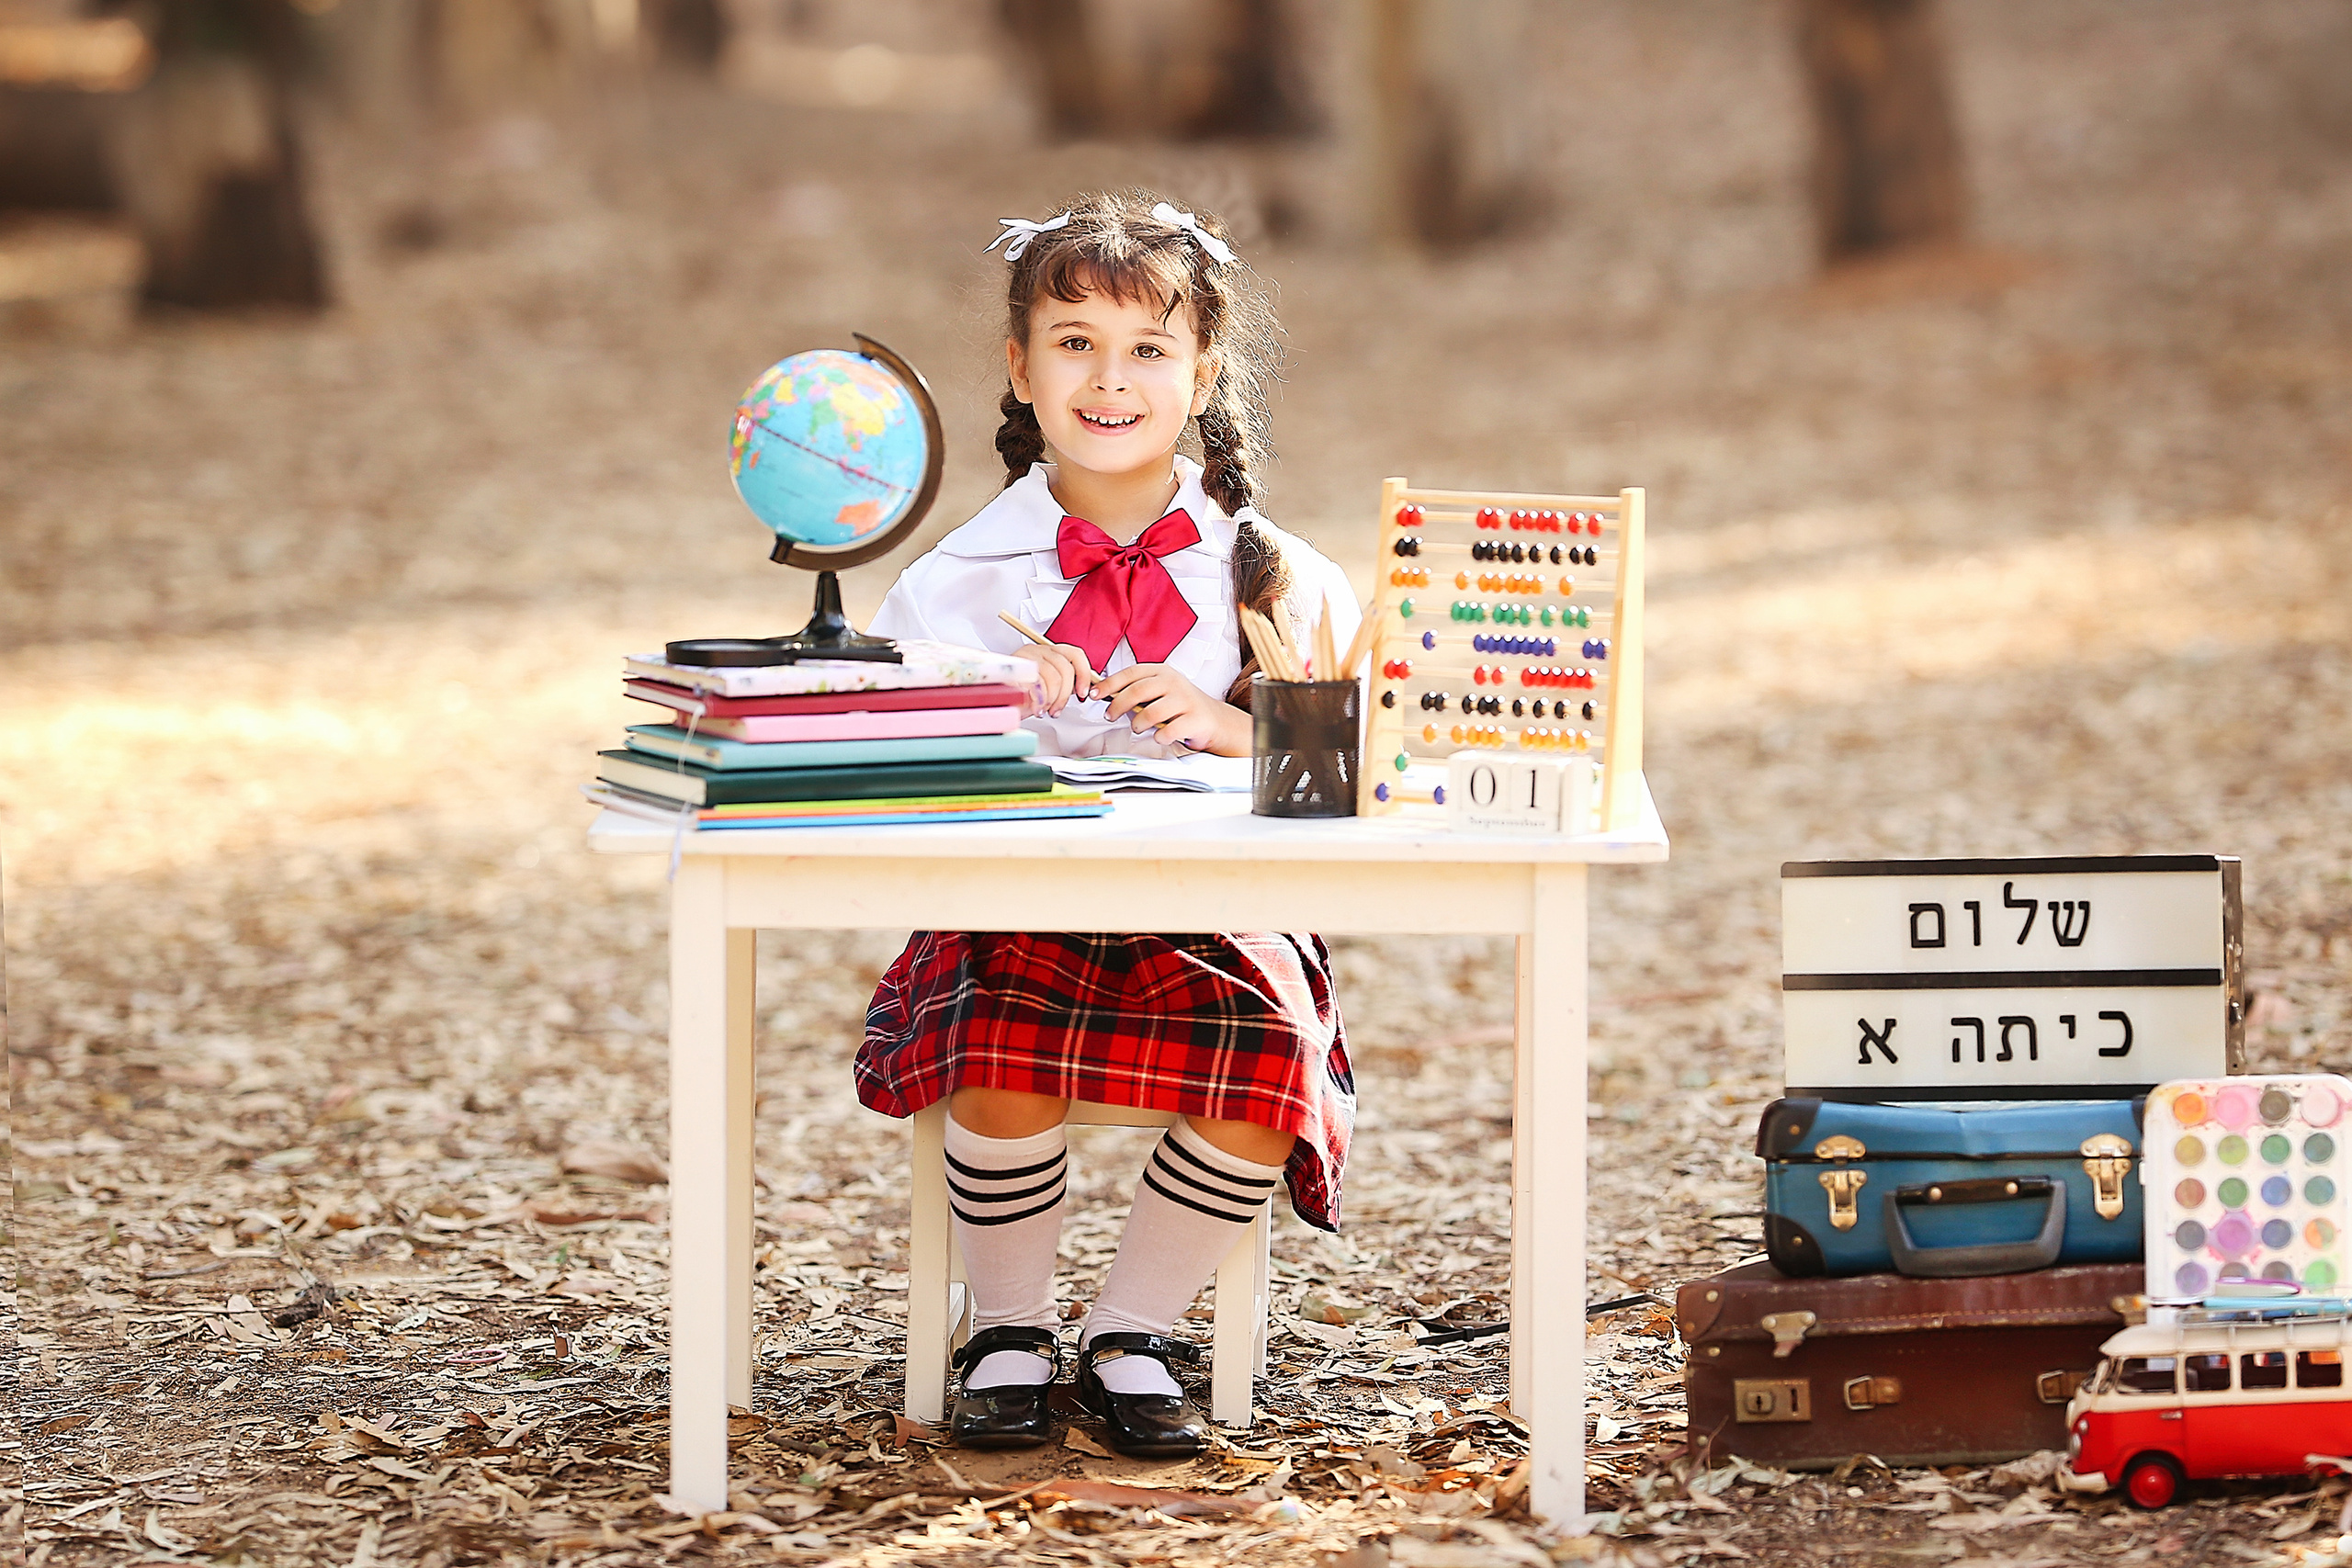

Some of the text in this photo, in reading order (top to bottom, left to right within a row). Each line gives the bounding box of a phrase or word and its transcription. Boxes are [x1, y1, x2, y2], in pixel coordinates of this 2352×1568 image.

[1908, 881, 2091, 949] שלום
[1857, 1010, 2134, 1065] כיתה א
